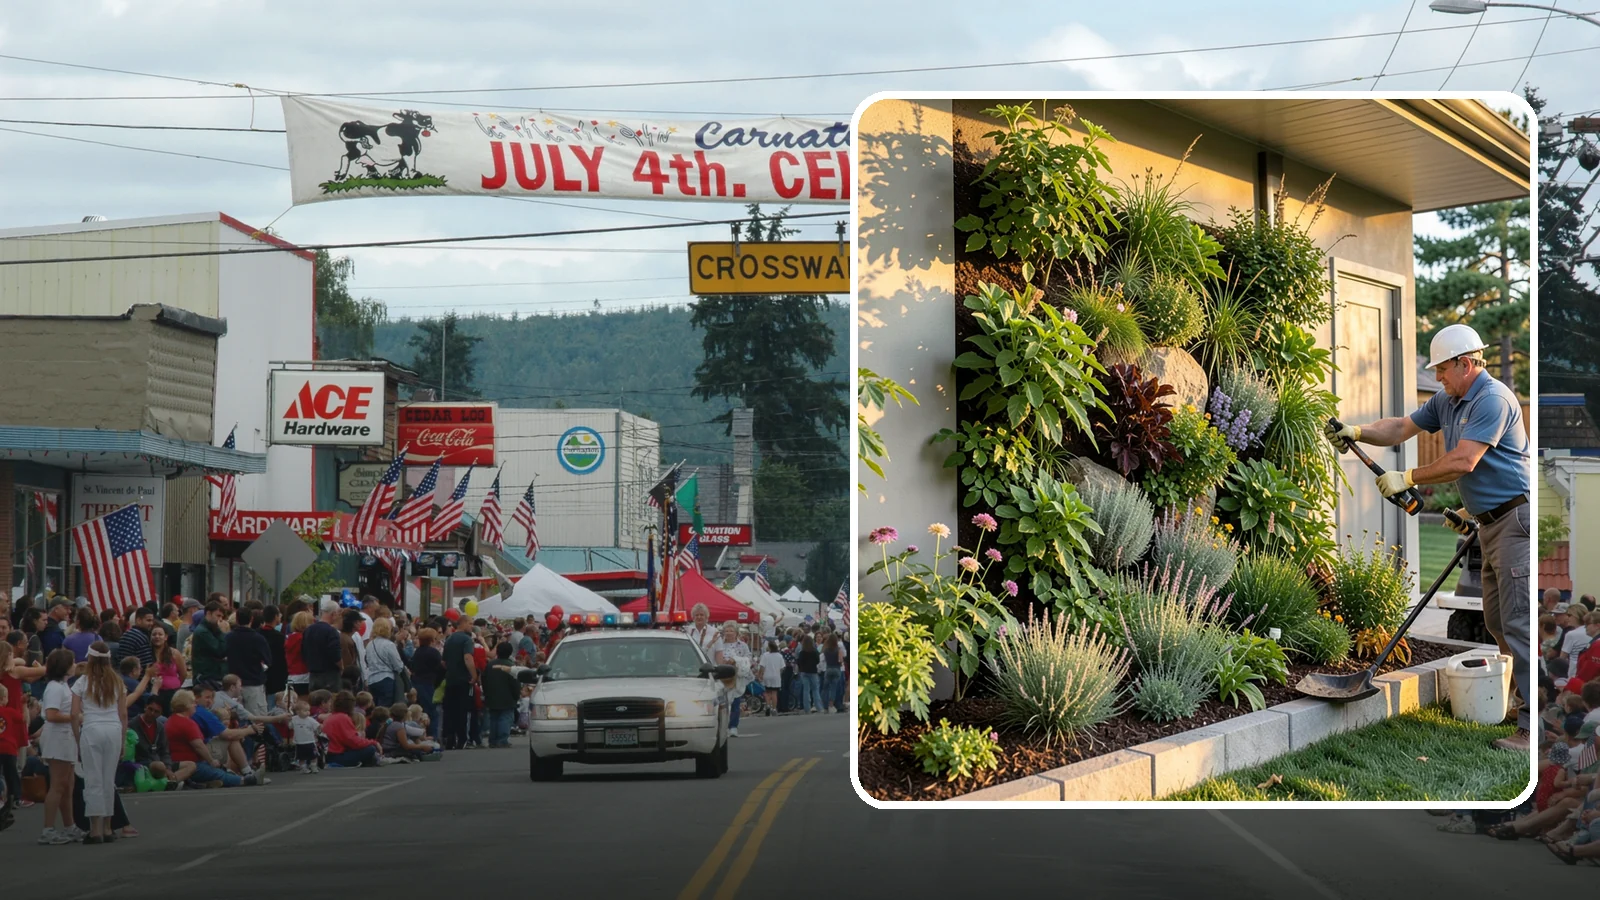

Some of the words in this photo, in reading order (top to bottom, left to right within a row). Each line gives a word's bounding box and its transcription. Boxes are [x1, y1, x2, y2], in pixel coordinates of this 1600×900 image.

[694, 121, 850, 150] Carnat
[481, 140, 605, 193] JULY
[632, 150, 747, 197] 4th.
[696, 254, 850, 280] CROSSWA
[283, 380, 373, 420] ACE
[406, 410, 452, 421] CEDAR
[283, 421, 371, 437] Hardware
[416, 428, 476, 446] Coca-Cola
[353, 466, 386, 480] Simpl
[96, 485, 124, 494] Vincent
[126, 486, 135, 494] de
[138, 486, 155, 495] Paul
[688, 526, 741, 535] CRNATION
[699, 535, 730, 543] GLASS
